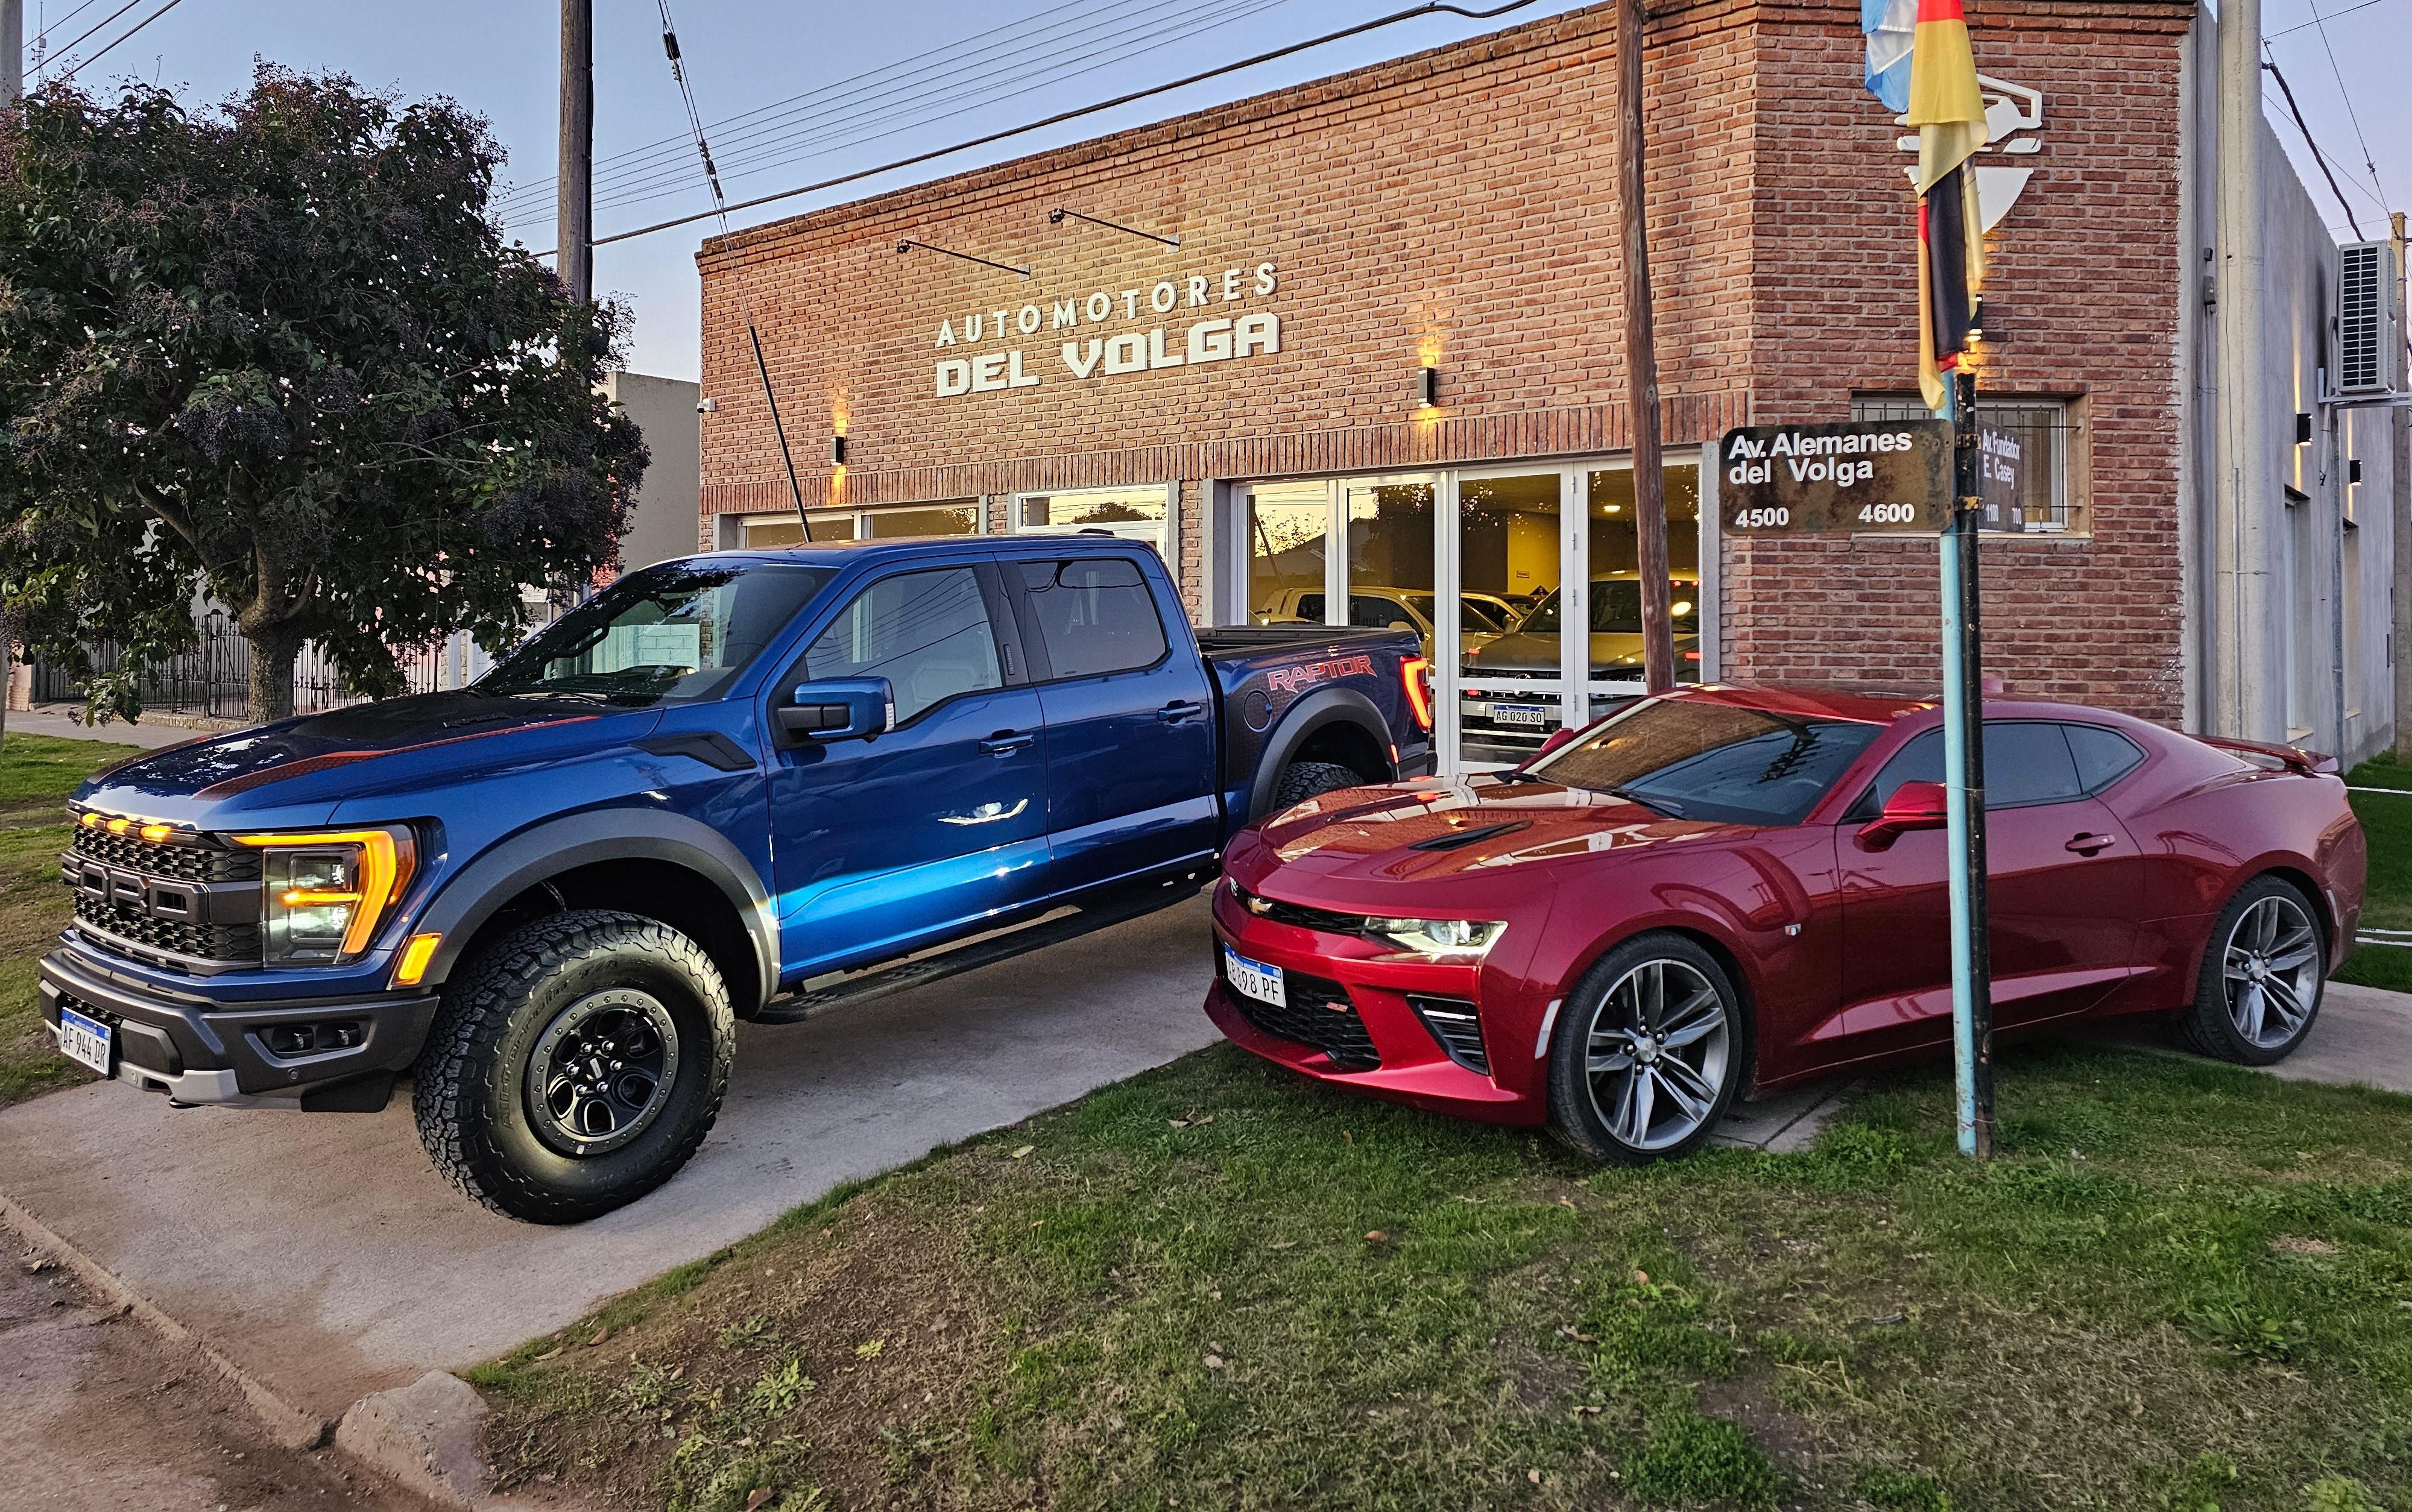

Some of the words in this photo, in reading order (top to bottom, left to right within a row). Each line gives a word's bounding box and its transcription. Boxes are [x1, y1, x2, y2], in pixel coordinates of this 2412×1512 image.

[936, 262, 1277, 348] AUTOMOTORES
[936, 351, 1040, 398] DEL
[1062, 311, 1280, 379] VOLGA
[1729, 435, 1766, 459] Av.
[1771, 432, 1913, 457] Alemanes
[1983, 429, 1992, 453] Av.
[1992, 431, 2020, 461] Fundador
[1729, 459, 1771, 485] del
[1788, 456, 1874, 487] Volga
[1995, 456, 2015, 490] Casey
[1735, 507, 1790, 528] 4500
[1858, 503, 1915, 523] 4600
[1268, 655, 1378, 694] RAPTOR
[1496, 711, 1508, 720] AG
[1510, 711, 1527, 722] 020
[1262, 977, 1278, 1000] PF
[63, 1025, 74, 1050] AF
[77, 1031, 92, 1061] 944
[95, 1039, 106, 1068] DR
